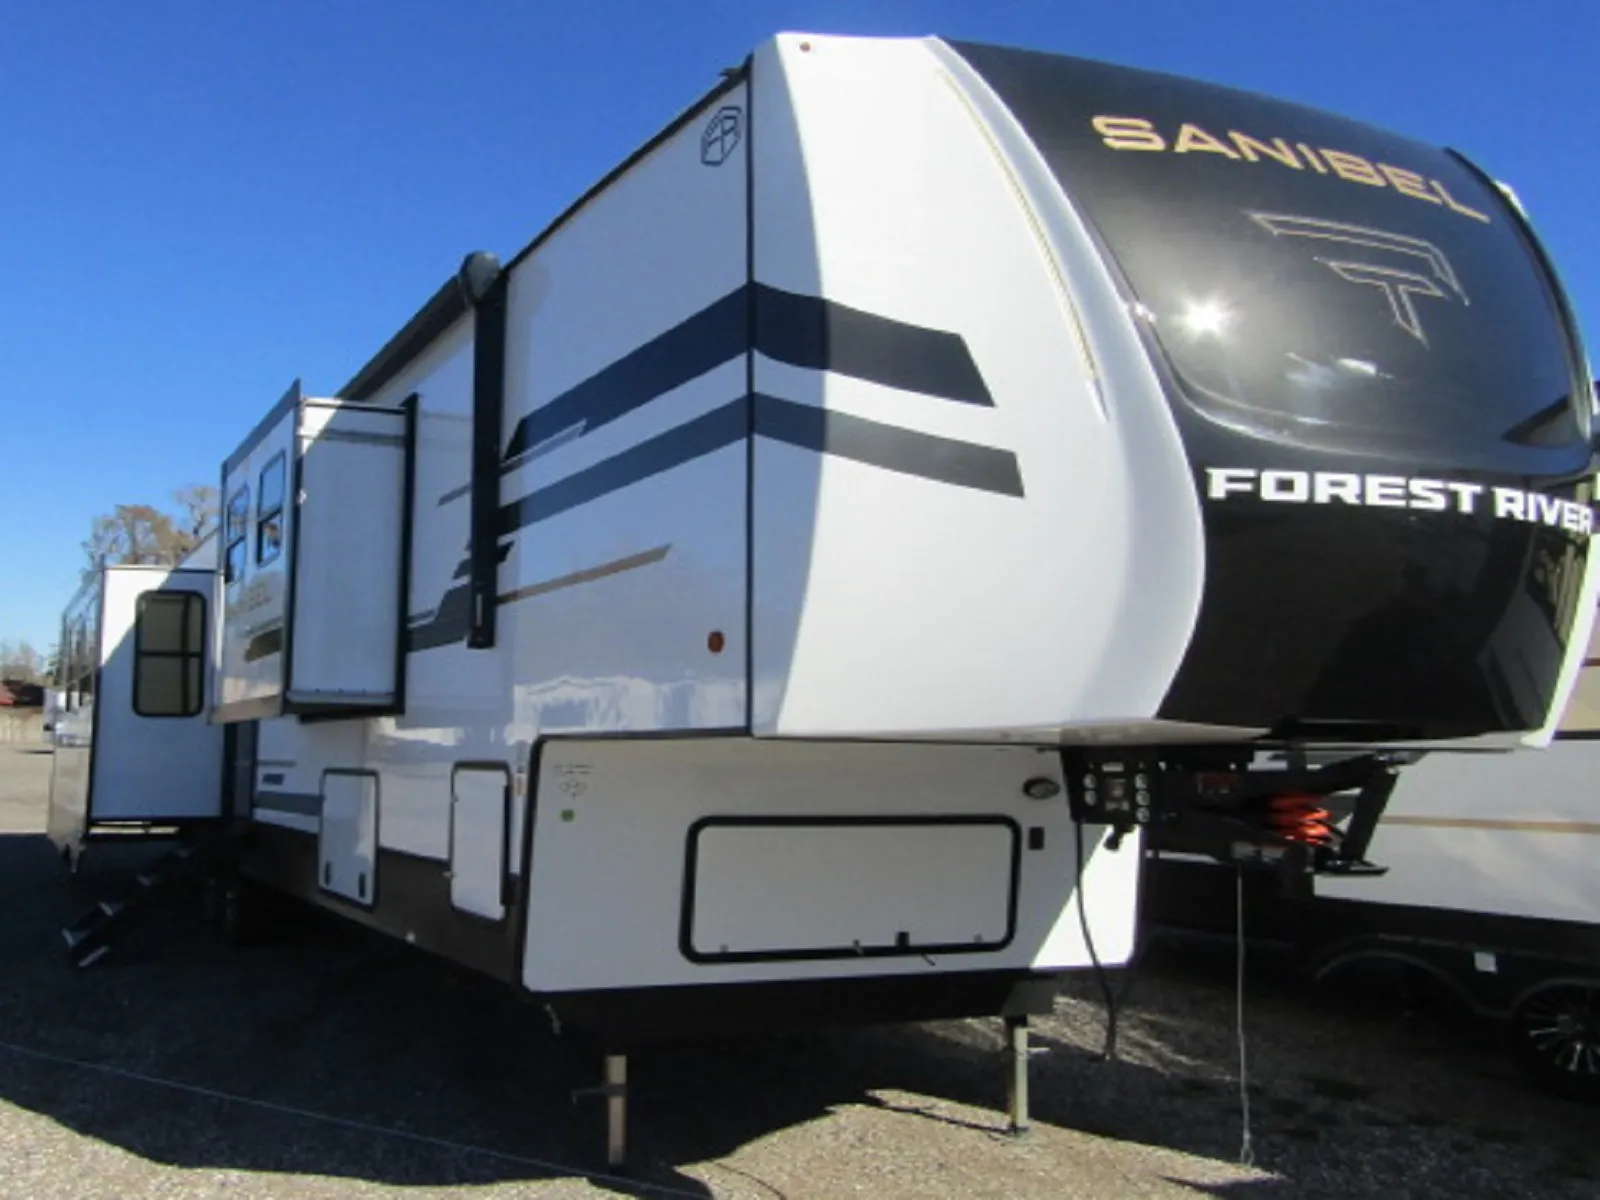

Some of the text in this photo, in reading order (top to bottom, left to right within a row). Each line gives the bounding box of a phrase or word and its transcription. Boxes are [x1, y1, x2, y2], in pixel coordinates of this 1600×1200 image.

[1092, 115, 1490, 223] SANIBEL
[1205, 468, 1592, 534] FOREST RIVER
